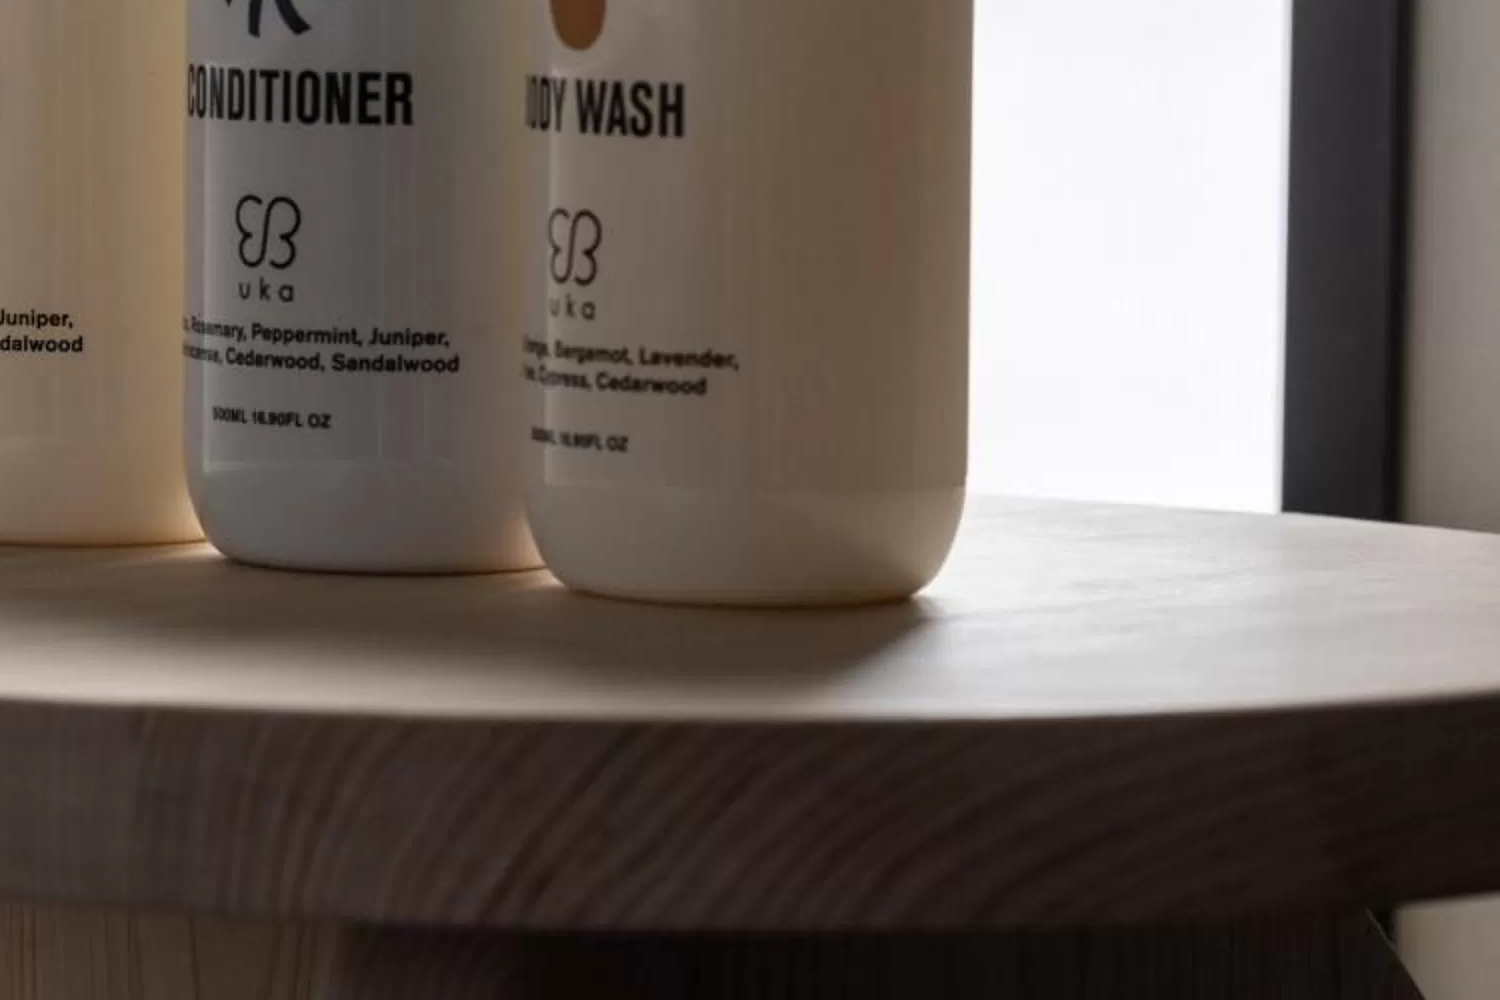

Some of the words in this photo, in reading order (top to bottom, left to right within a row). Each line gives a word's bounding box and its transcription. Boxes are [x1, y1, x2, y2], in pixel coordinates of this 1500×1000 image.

[187, 63, 414, 126] CONDITIONER
[525, 75, 567, 133] ODY
[575, 79, 685, 138] WASH
[238, 277, 294, 302] uka
[549, 294, 597, 321] uka
[251, 321, 363, 348] Peppermint,
[368, 328, 450, 350] Juniper,
[225, 346, 326, 372] Cedarwood,
[331, 353, 461, 374] Sandalwood
[638, 345, 740, 372] Lavender,
[595, 370, 708, 396] Cedarwood
[307, 412, 332, 430] OZ
